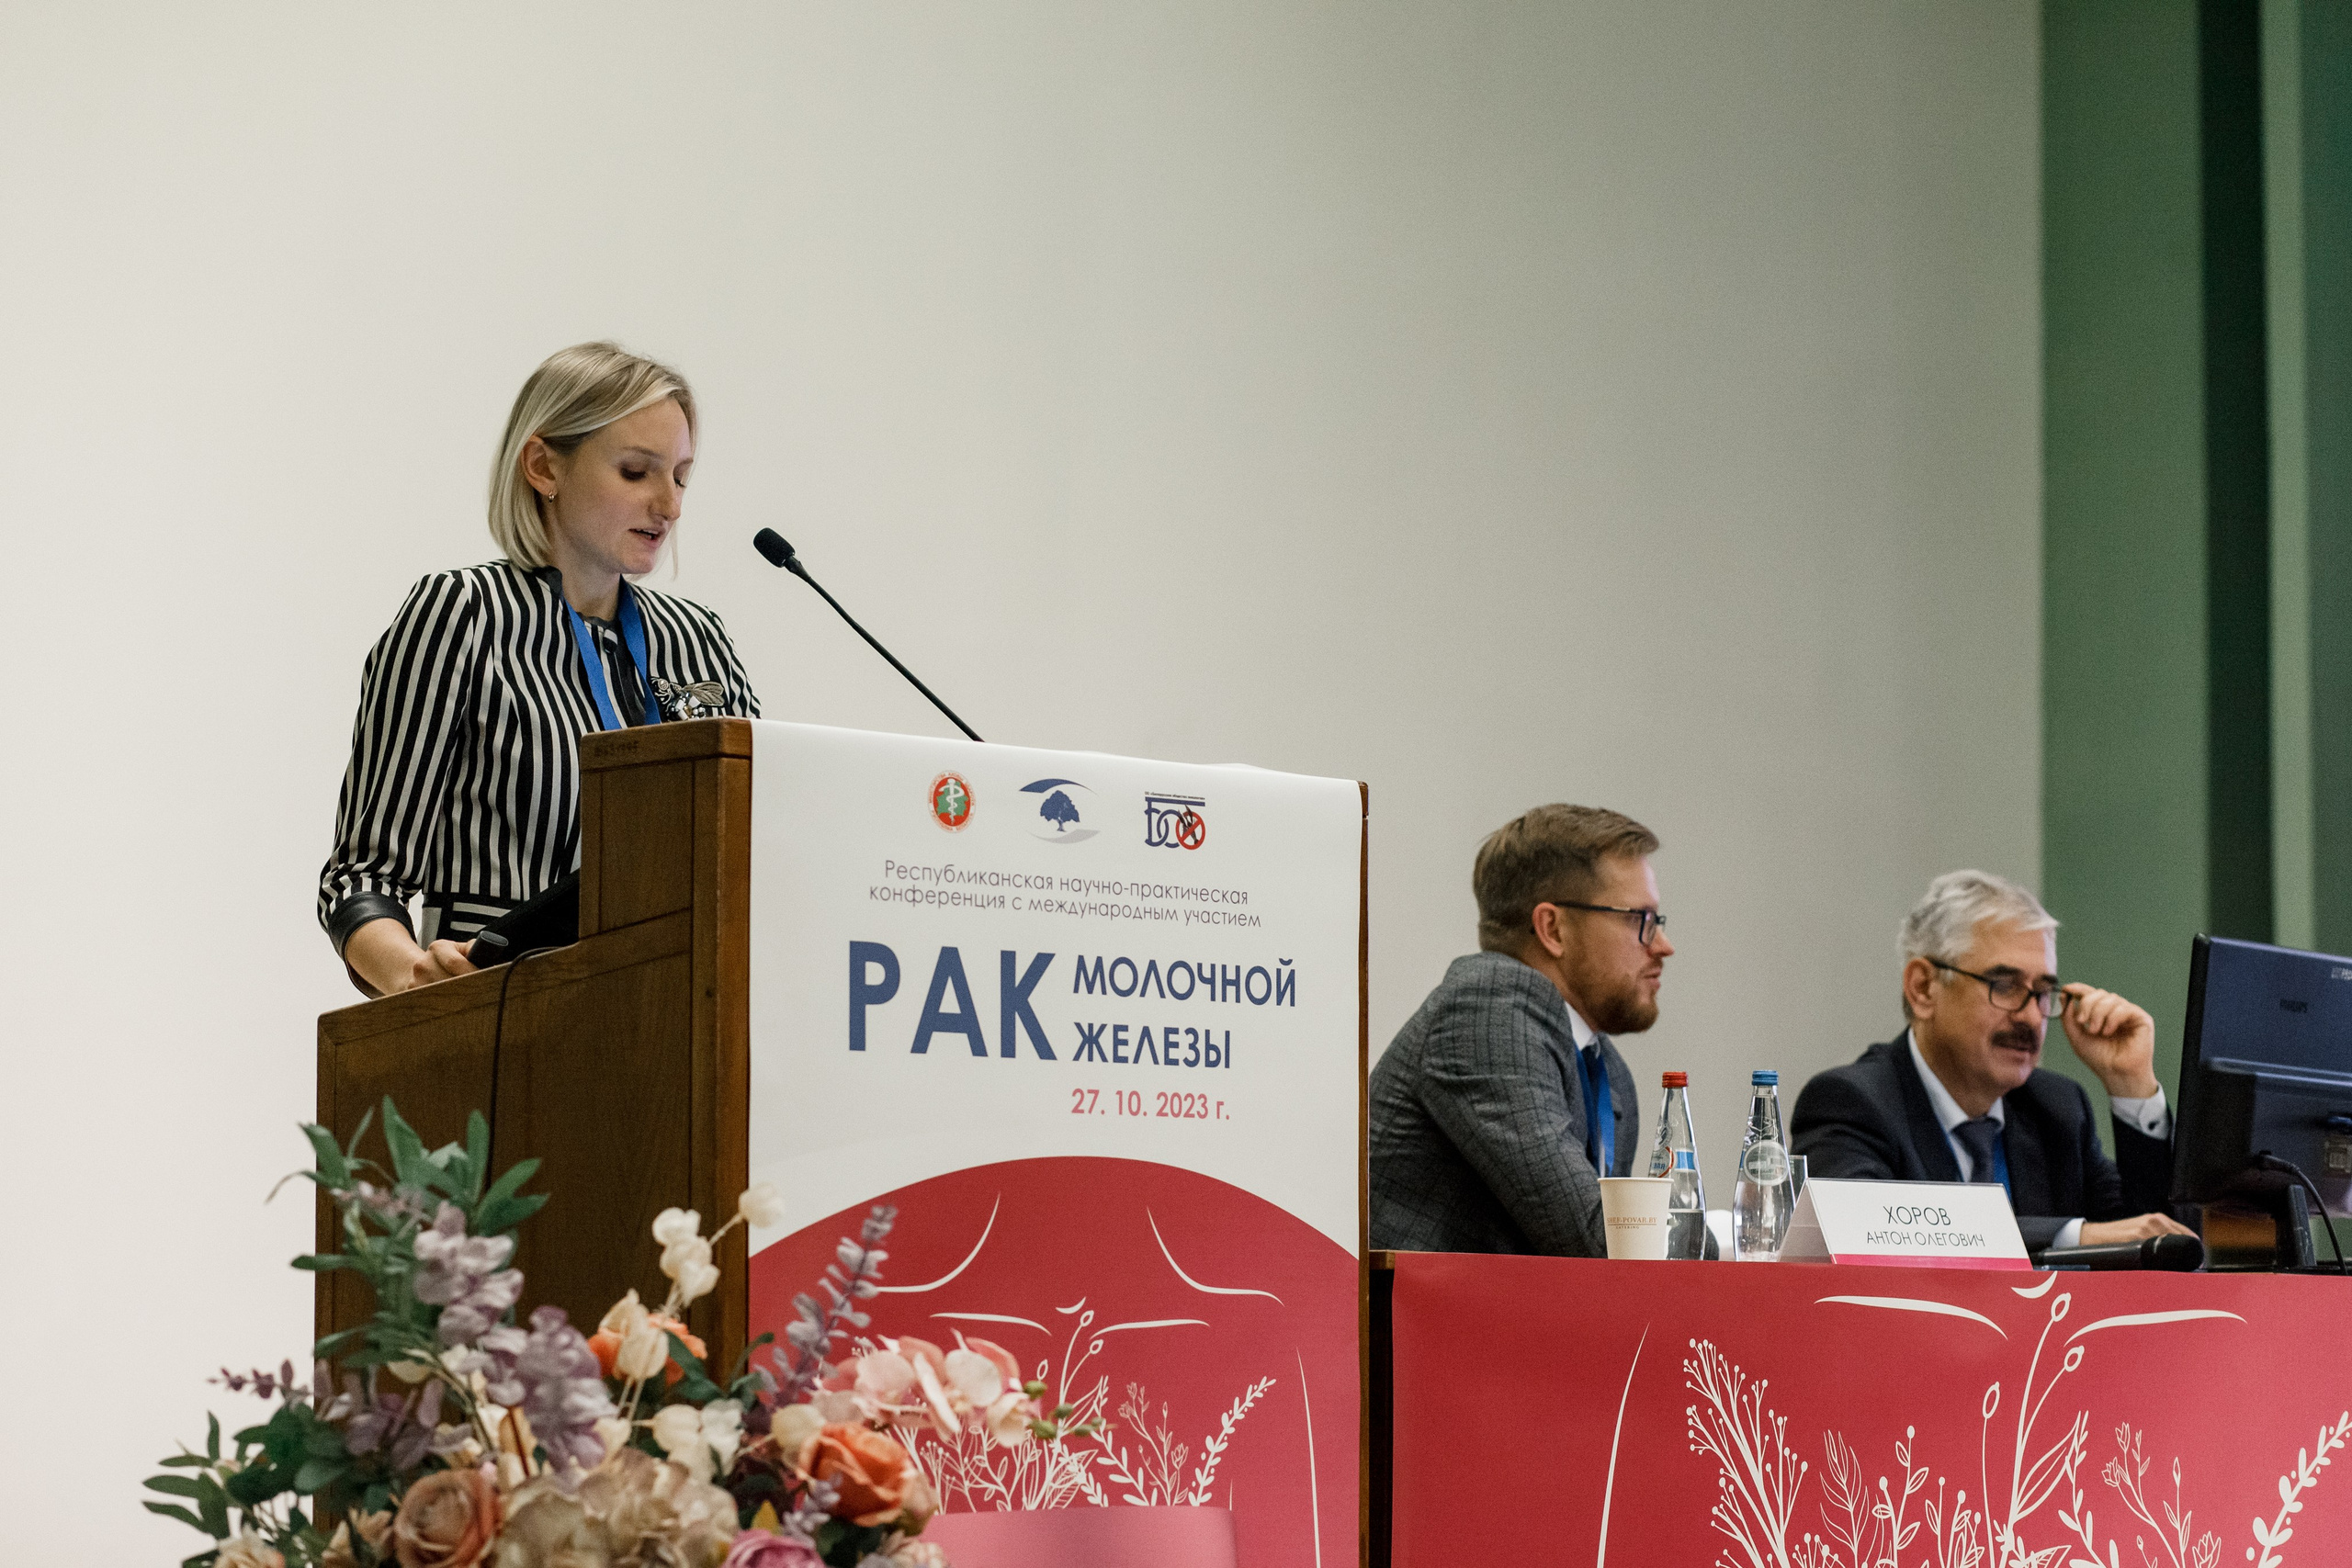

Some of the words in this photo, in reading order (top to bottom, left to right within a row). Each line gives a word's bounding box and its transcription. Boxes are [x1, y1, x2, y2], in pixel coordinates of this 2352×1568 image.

[885, 860, 1054, 890] Республиканская
[1059, 876, 1249, 905] научно-практическая
[869, 885, 1005, 909] конференция
[1012, 895, 1022, 910] с
[1028, 895, 1179, 921] международным
[1183, 908, 1261, 928] участием
[849, 941, 1057, 1061] РАК
[1073, 954, 1295, 1007] МОЛОЧНОЙ
[1072, 1022, 1230, 1068] ЖЕЛЕЗЫ
[1071, 1088, 1105, 1115] 27.
[1115, 1090, 1148, 1117] 10.
[1156, 1091, 1209, 1120] 2023
[1216, 1100, 1230, 1121] г.
[1883, 1205, 1951, 1226] ХОРОВ
[1867, 1231, 1912, 1246] АНТОН
[1915, 1232, 1985, 1247] ОЛЕГОВИЧ
